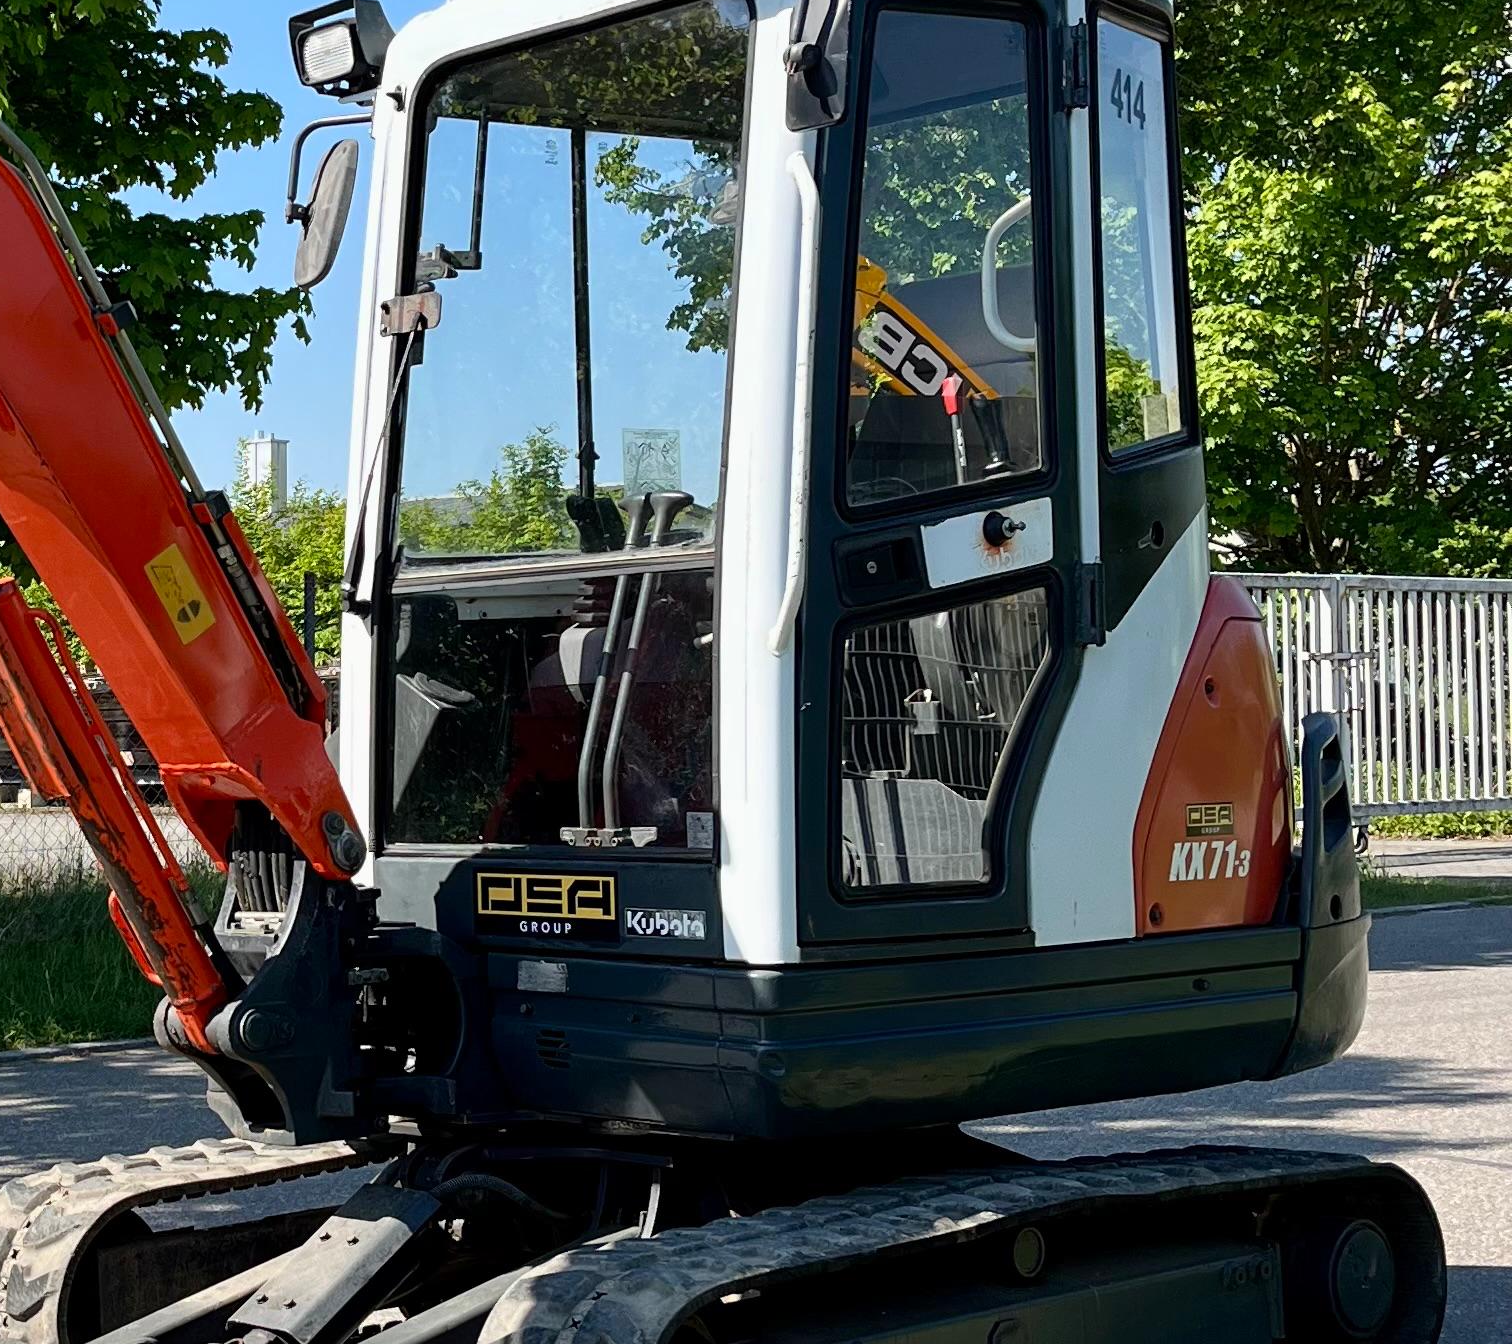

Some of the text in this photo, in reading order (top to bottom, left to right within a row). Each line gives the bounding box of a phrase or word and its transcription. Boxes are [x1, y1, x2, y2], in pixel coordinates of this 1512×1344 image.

[1110, 67, 1146, 131] 414
[519, 920, 572, 935] GROUP
[626, 910, 706, 940] Kubota
